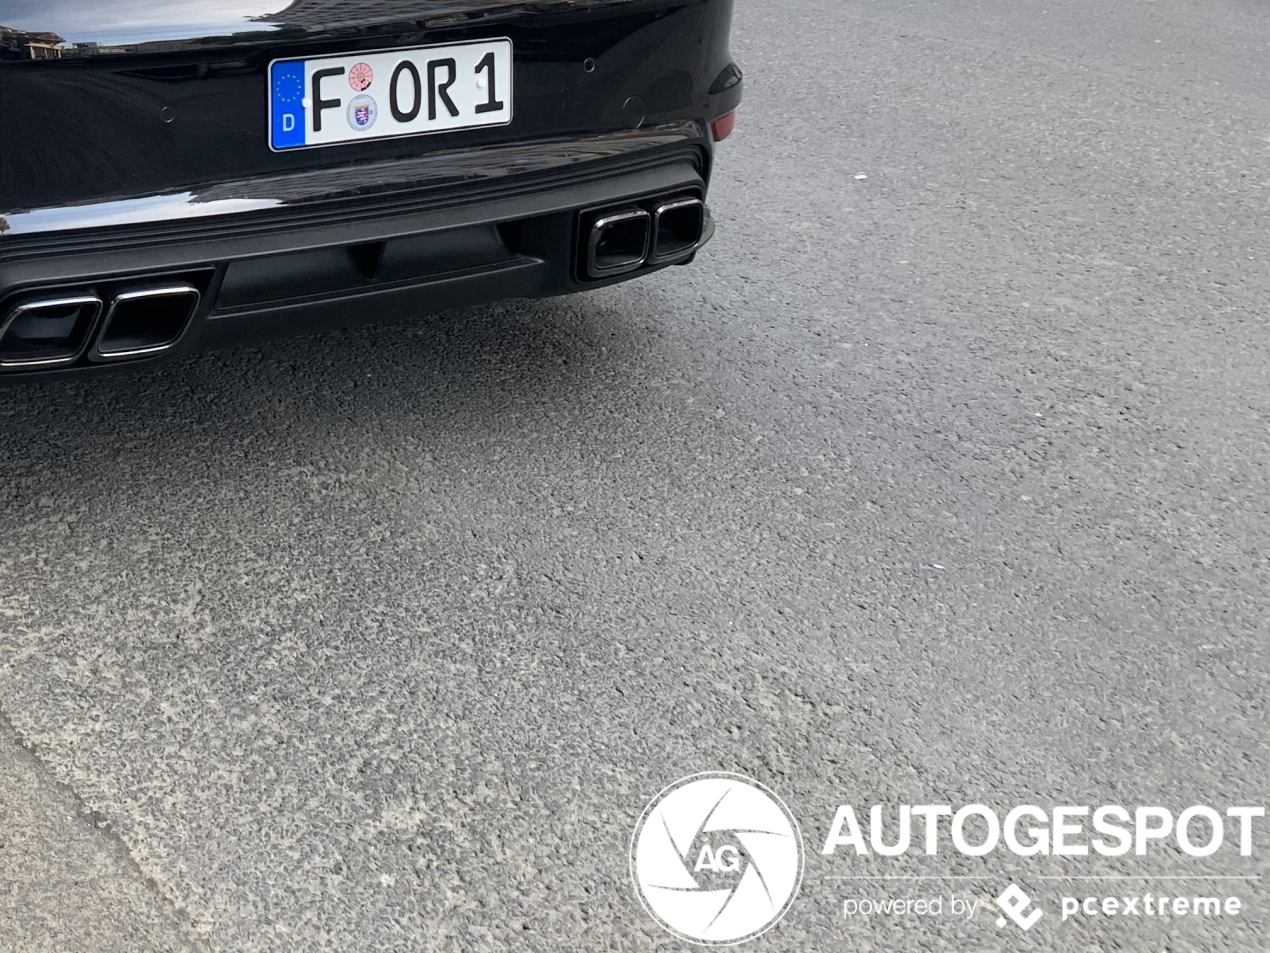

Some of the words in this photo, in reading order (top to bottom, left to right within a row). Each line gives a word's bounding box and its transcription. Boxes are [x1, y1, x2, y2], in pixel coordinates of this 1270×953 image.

[312, 66, 345, 132] F
[389, 57, 460, 123] OR
[474, 52, 504, 114] 1
[282, 113, 295, 132] D
